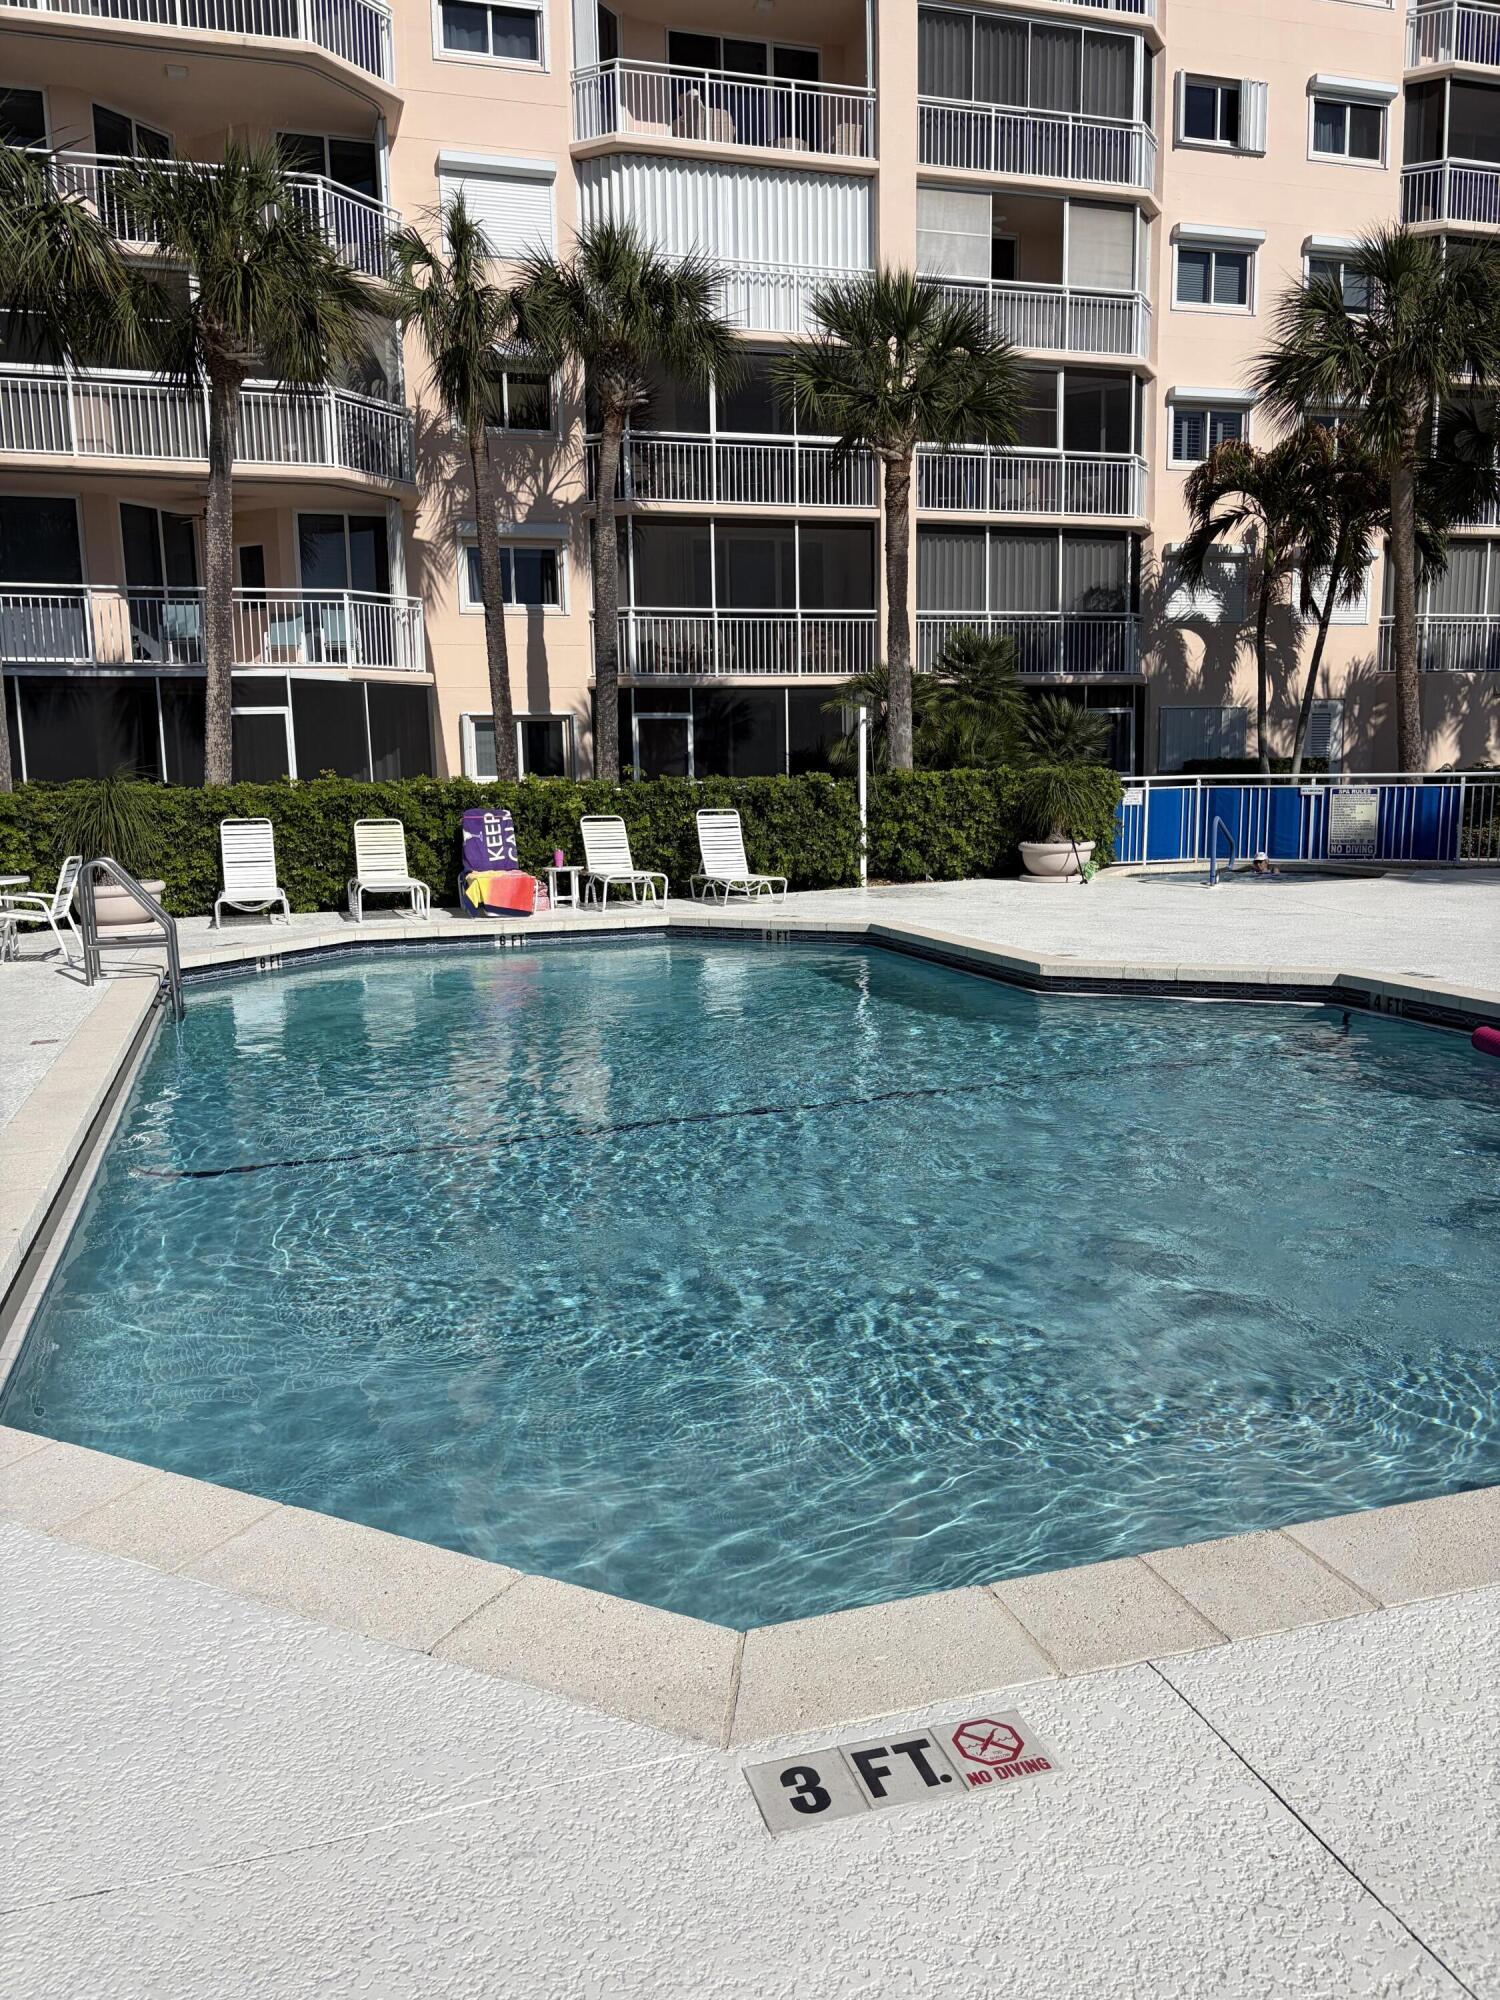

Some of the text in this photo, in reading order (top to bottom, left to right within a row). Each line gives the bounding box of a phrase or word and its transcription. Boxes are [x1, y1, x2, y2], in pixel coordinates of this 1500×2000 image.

[484, 813, 505, 861] KEEP
[1331, 845, 1373, 853] NO DIVING
[499, 935, 506, 946] 6
[766, 931, 772, 940] 6
[779, 1738, 1052, 1814] 3 FT. NO DIVING
